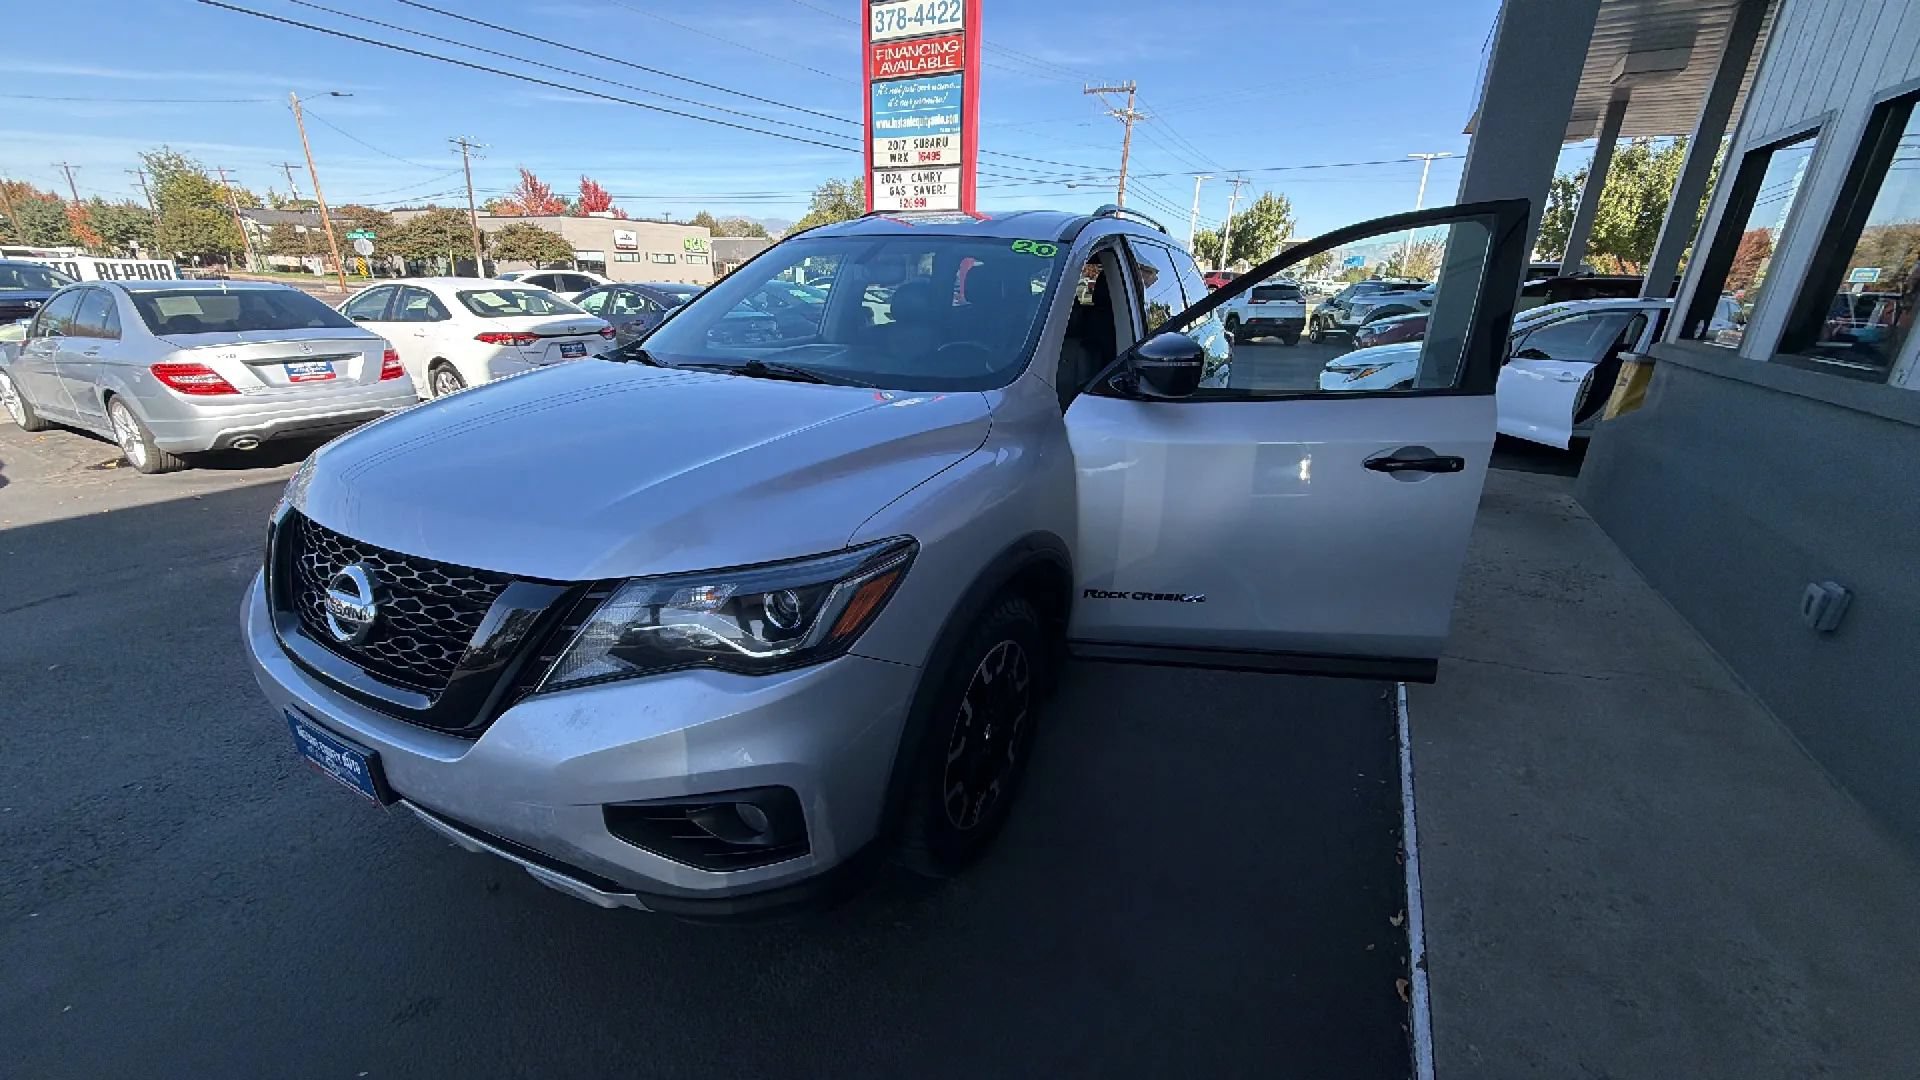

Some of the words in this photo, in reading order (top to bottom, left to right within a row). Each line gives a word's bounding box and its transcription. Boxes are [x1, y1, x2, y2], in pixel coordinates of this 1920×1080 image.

[875, 0, 961, 33] 378-4422
[876, 39, 960, 61] FINANCING
[880, 55, 956, 75] AVAILABLE
[888, 139, 906, 151] 2017
[913, 136, 949, 149] SUBARU
[890, 152, 909, 163] WRX
[881, 173, 902, 185] 2024
[911, 171, 943, 183] CAMRY
[890, 185, 906, 197] GAS
[913, 183, 947, 196] SAVER!
[1012, 240, 1058, 257] 20
[94, 261, 173, 280] REPAIR
